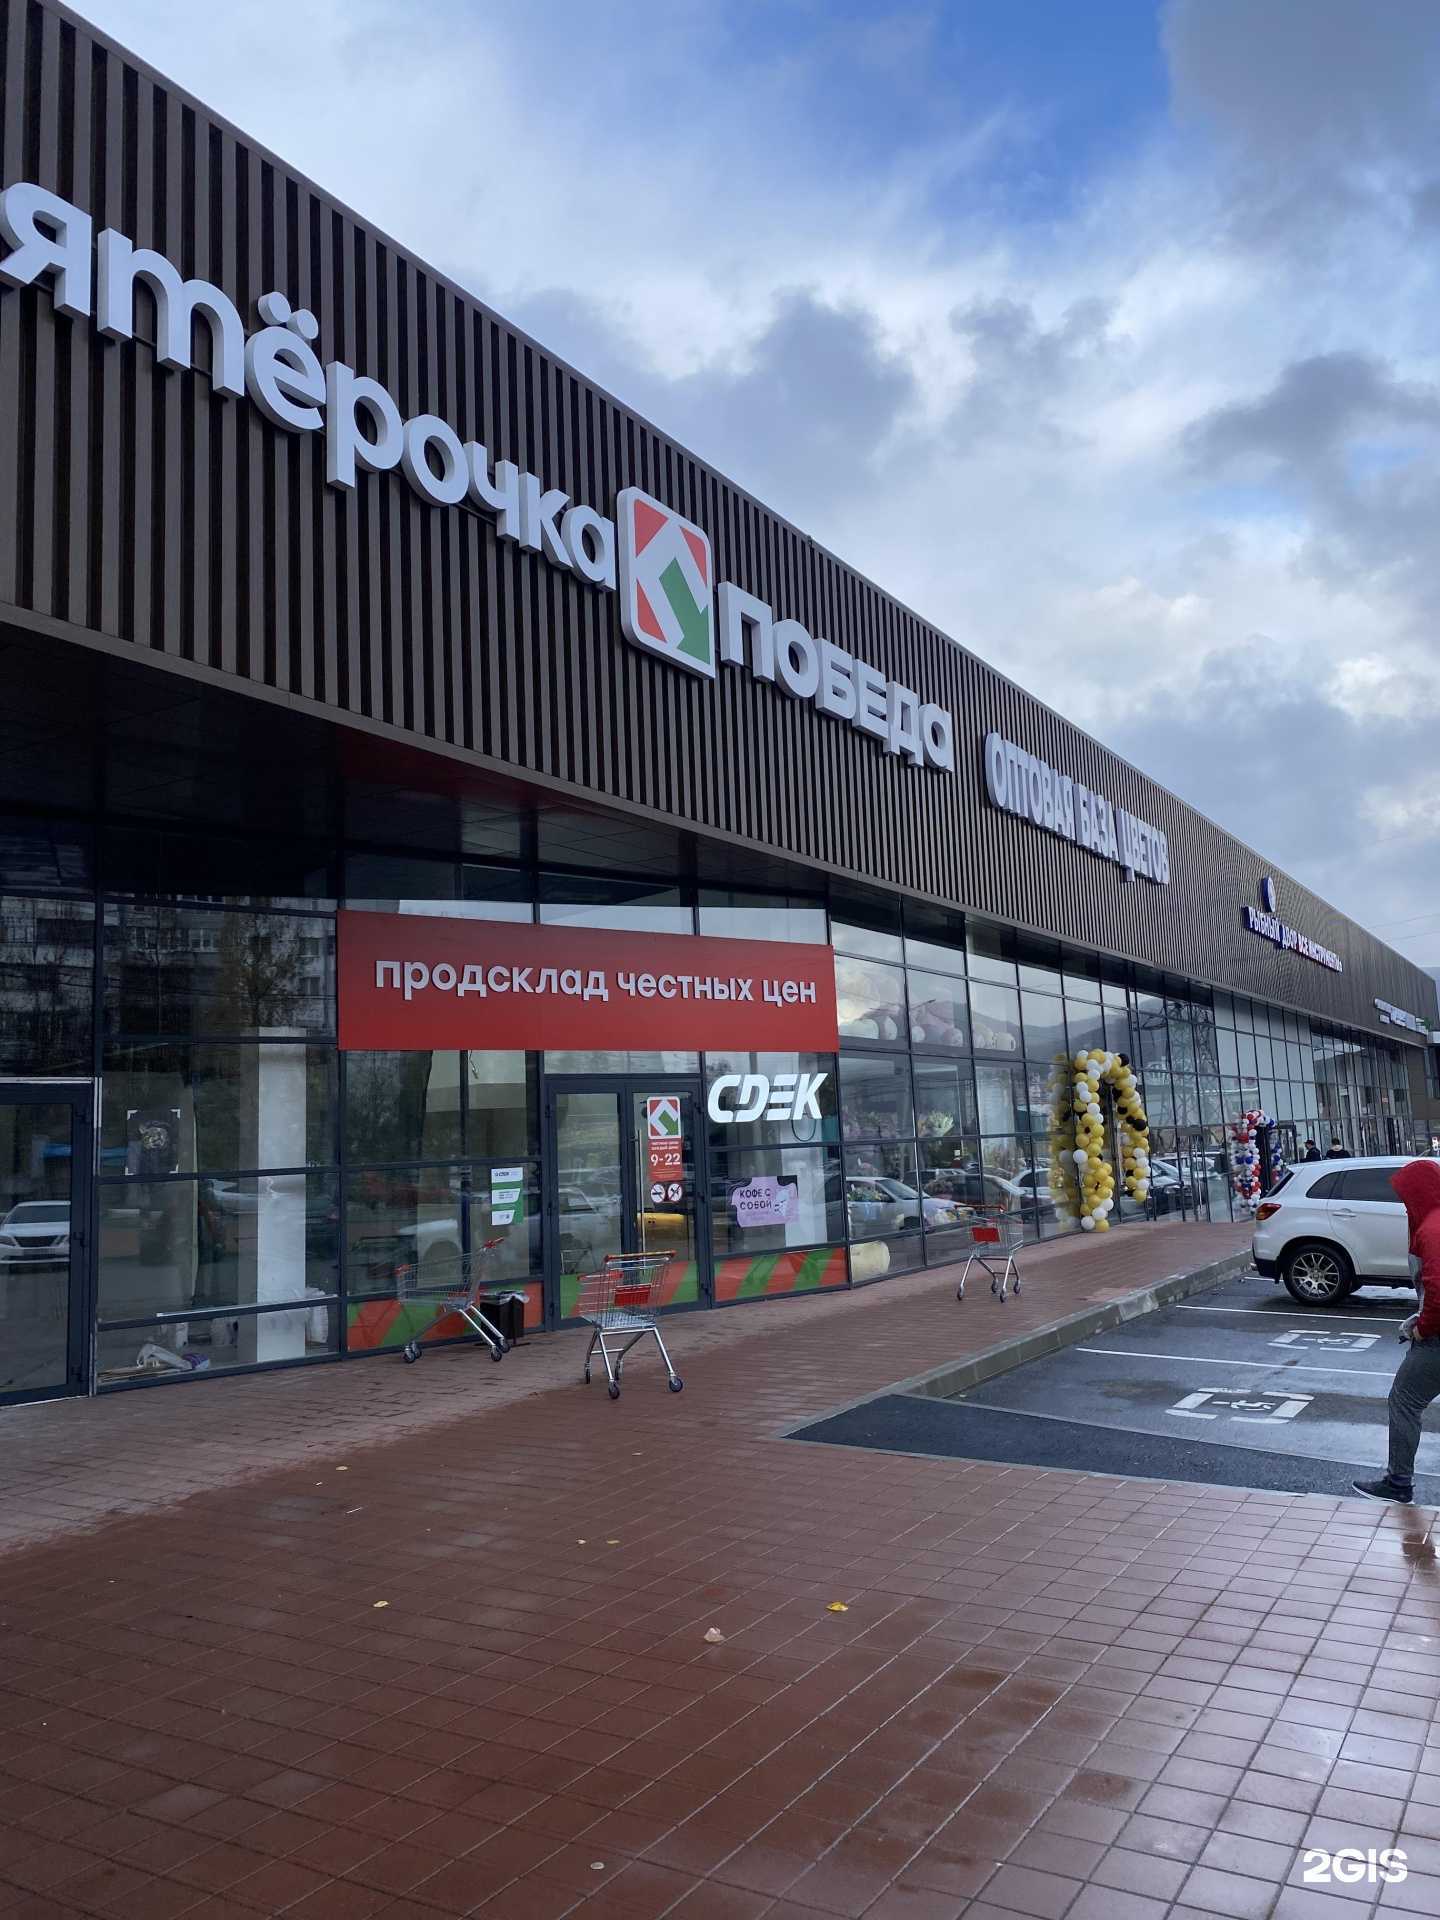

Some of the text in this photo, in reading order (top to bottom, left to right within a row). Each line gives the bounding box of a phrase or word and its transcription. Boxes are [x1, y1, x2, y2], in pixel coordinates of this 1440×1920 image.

[985, 732, 1169, 885] ОПТОВАЯ БАЗА ЦВЕТОВ
[375, 959, 816, 1008] продсклад честных цен
[740, 1188, 762, 1199] КОФЕ
